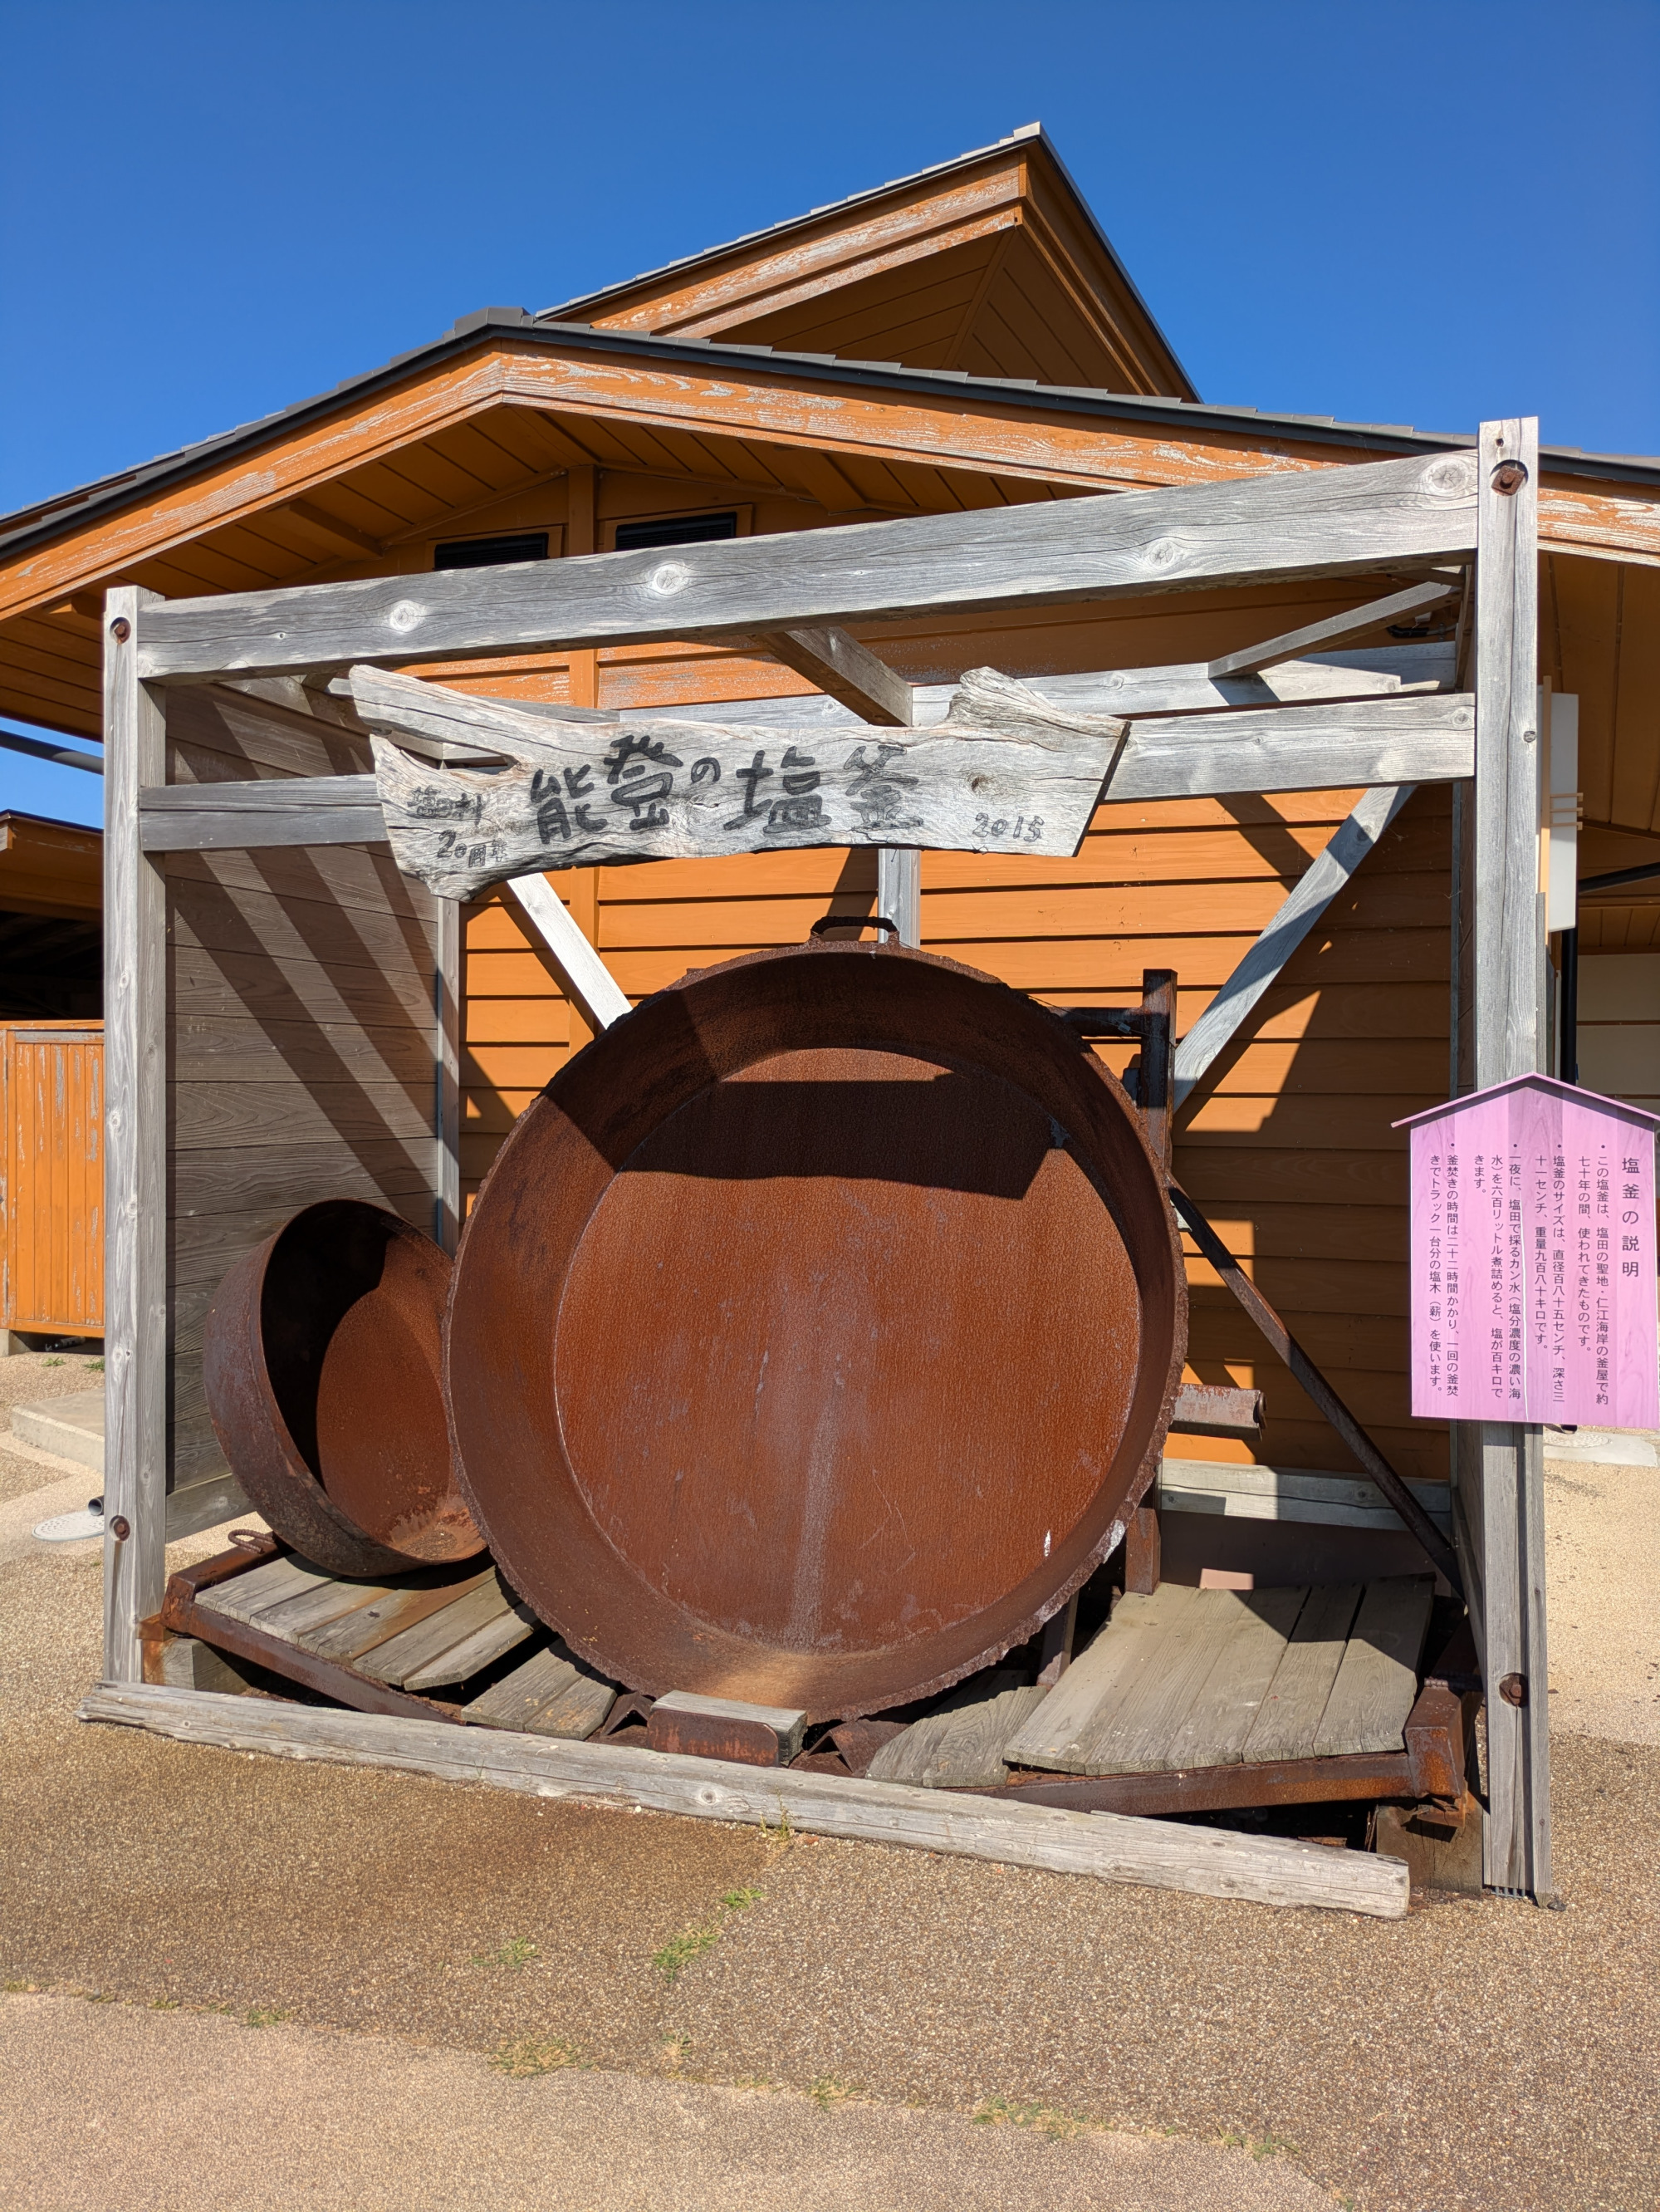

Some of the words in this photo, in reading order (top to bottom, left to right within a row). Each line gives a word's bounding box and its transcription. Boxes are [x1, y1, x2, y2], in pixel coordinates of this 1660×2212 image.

[531, 734, 923, 845] 能登の塩釜
[972, 812, 1045, 842] 2015
[1473, 1155, 1486, 1194] きます。
[1621, 1157, 1640, 1278] 塩釜の説明
[1535, 1155, 1548, 1349] 十一センチ、重量九百八十キロです。
[1553, 1155, 1565, 1402] 塩釜のサイズは、直径百八十五センチ、深さ三
[1578, 1155, 1591, 1351] 七十年の間、使われてきたものです。
